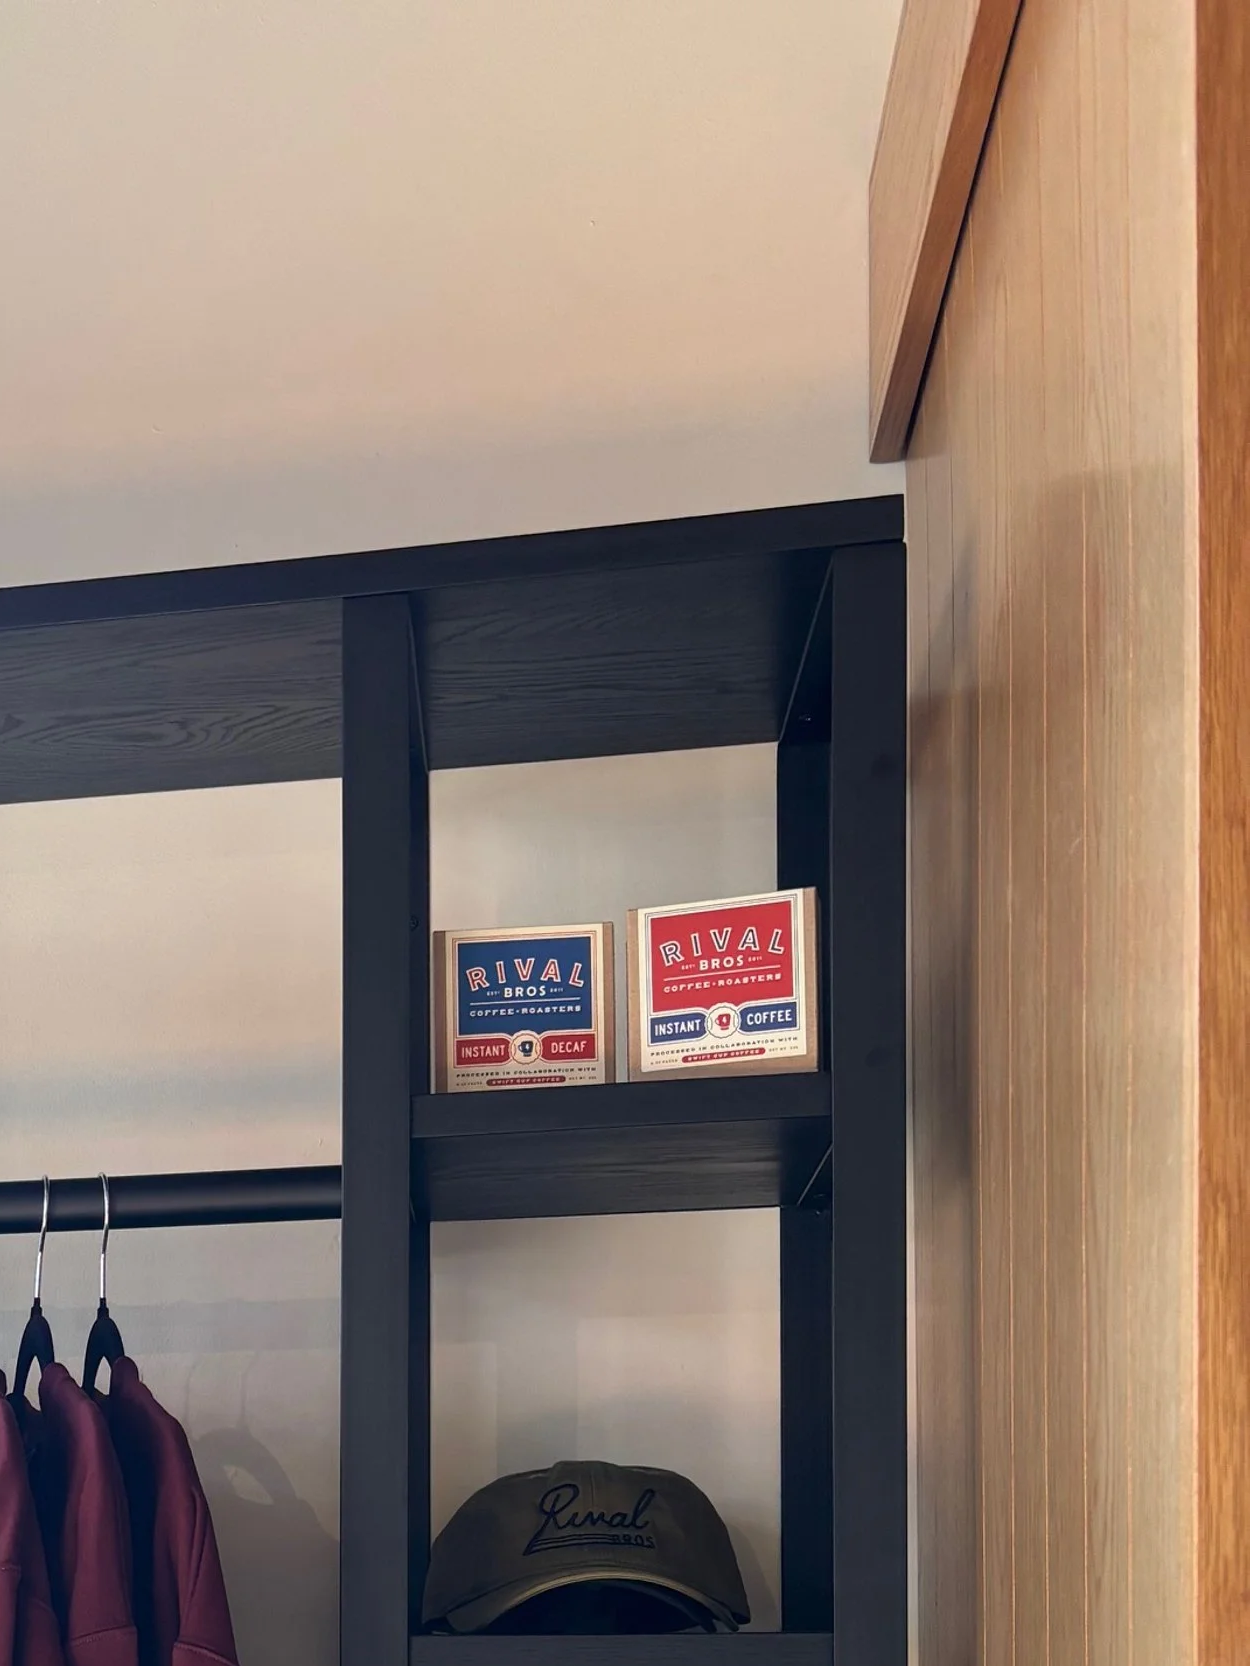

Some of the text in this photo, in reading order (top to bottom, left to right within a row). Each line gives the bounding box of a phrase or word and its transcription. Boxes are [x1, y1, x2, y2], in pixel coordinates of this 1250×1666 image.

[659, 927, 785, 967] RIVAL
[699, 955, 744, 971] BROS
[466, 957, 585, 992] RIVAL
[663, 973, 782, 993] COFFEE ROASTERS
[504, 985, 546, 998] BROS
[469, 1005, 581, 1017] COFFEE ROASTERS
[746, 1009, 792, 1026] COFFEE
[654, 1018, 701, 1036] INSTANT
[461, 1045, 506, 1059] INSTANT
[551, 1040, 588, 1054] DECAF
[710, 1038, 775, 1050] COLLABORATION
[514, 1067, 574, 1076] COLLABORATION
[525, 1483, 656, 1545] Rival
